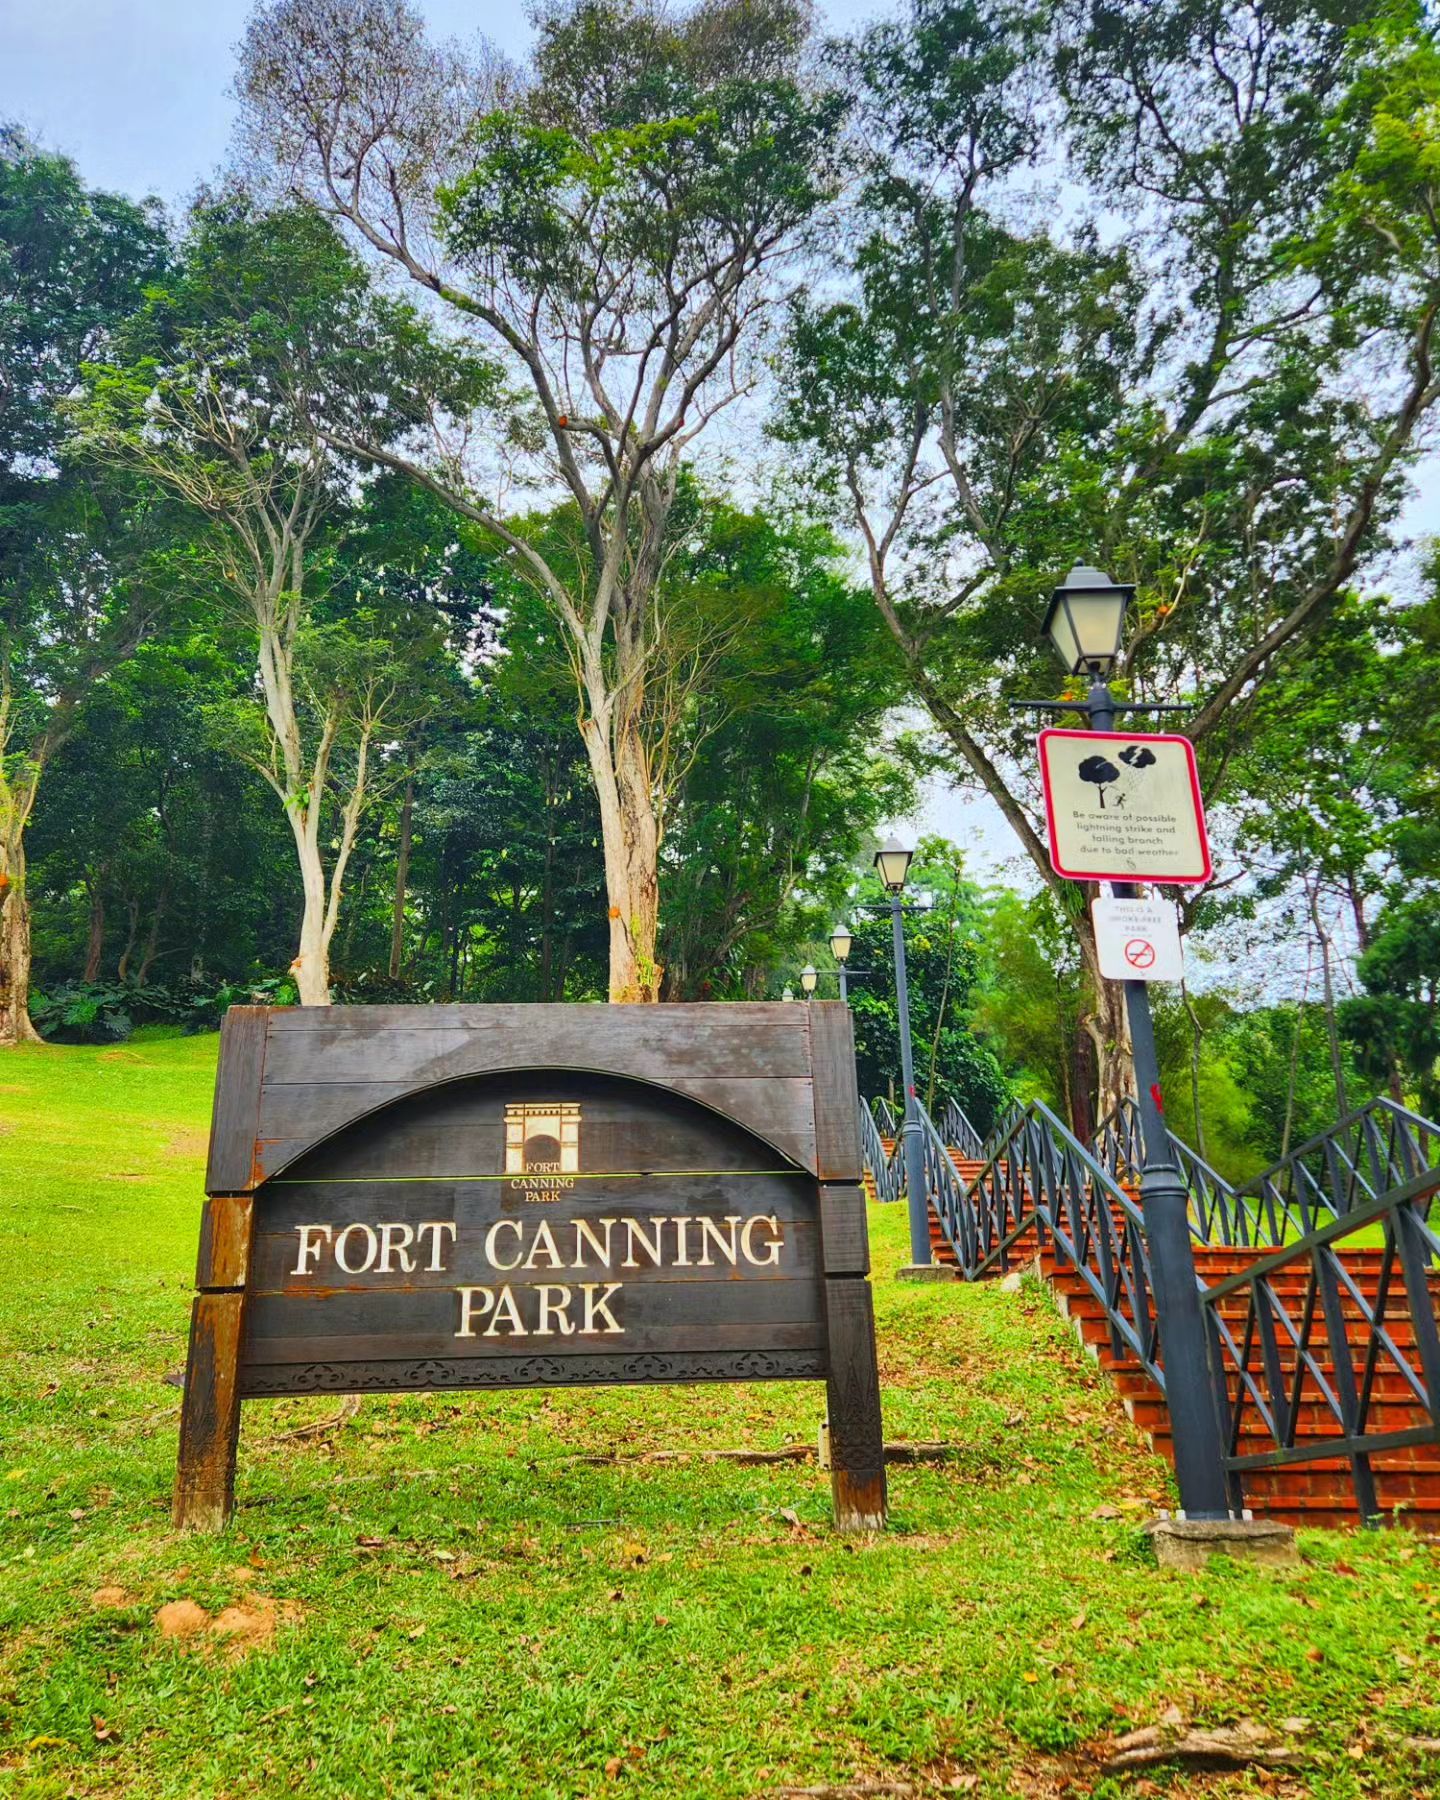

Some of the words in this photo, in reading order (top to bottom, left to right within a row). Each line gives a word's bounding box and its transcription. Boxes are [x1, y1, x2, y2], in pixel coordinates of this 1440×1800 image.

[1136, 814, 1176, 823] possible
[1077, 822, 1122, 833] lightning
[1125, 825, 1152, 833] strike
[1092, 834, 1125, 845] falling
[1127, 836, 1163, 844] branch
[1080, 845, 1098, 853] due
[1114, 847, 1134, 855] bad
[526, 1162, 560, 1173] FORT
[511, 1178, 574, 1189] CANNING
[525, 1191, 560, 1202] PARK
[290, 1221, 457, 1275] FORT
[485, 1215, 784, 1271] CANNING
[454, 1282, 625, 1337] PARK
